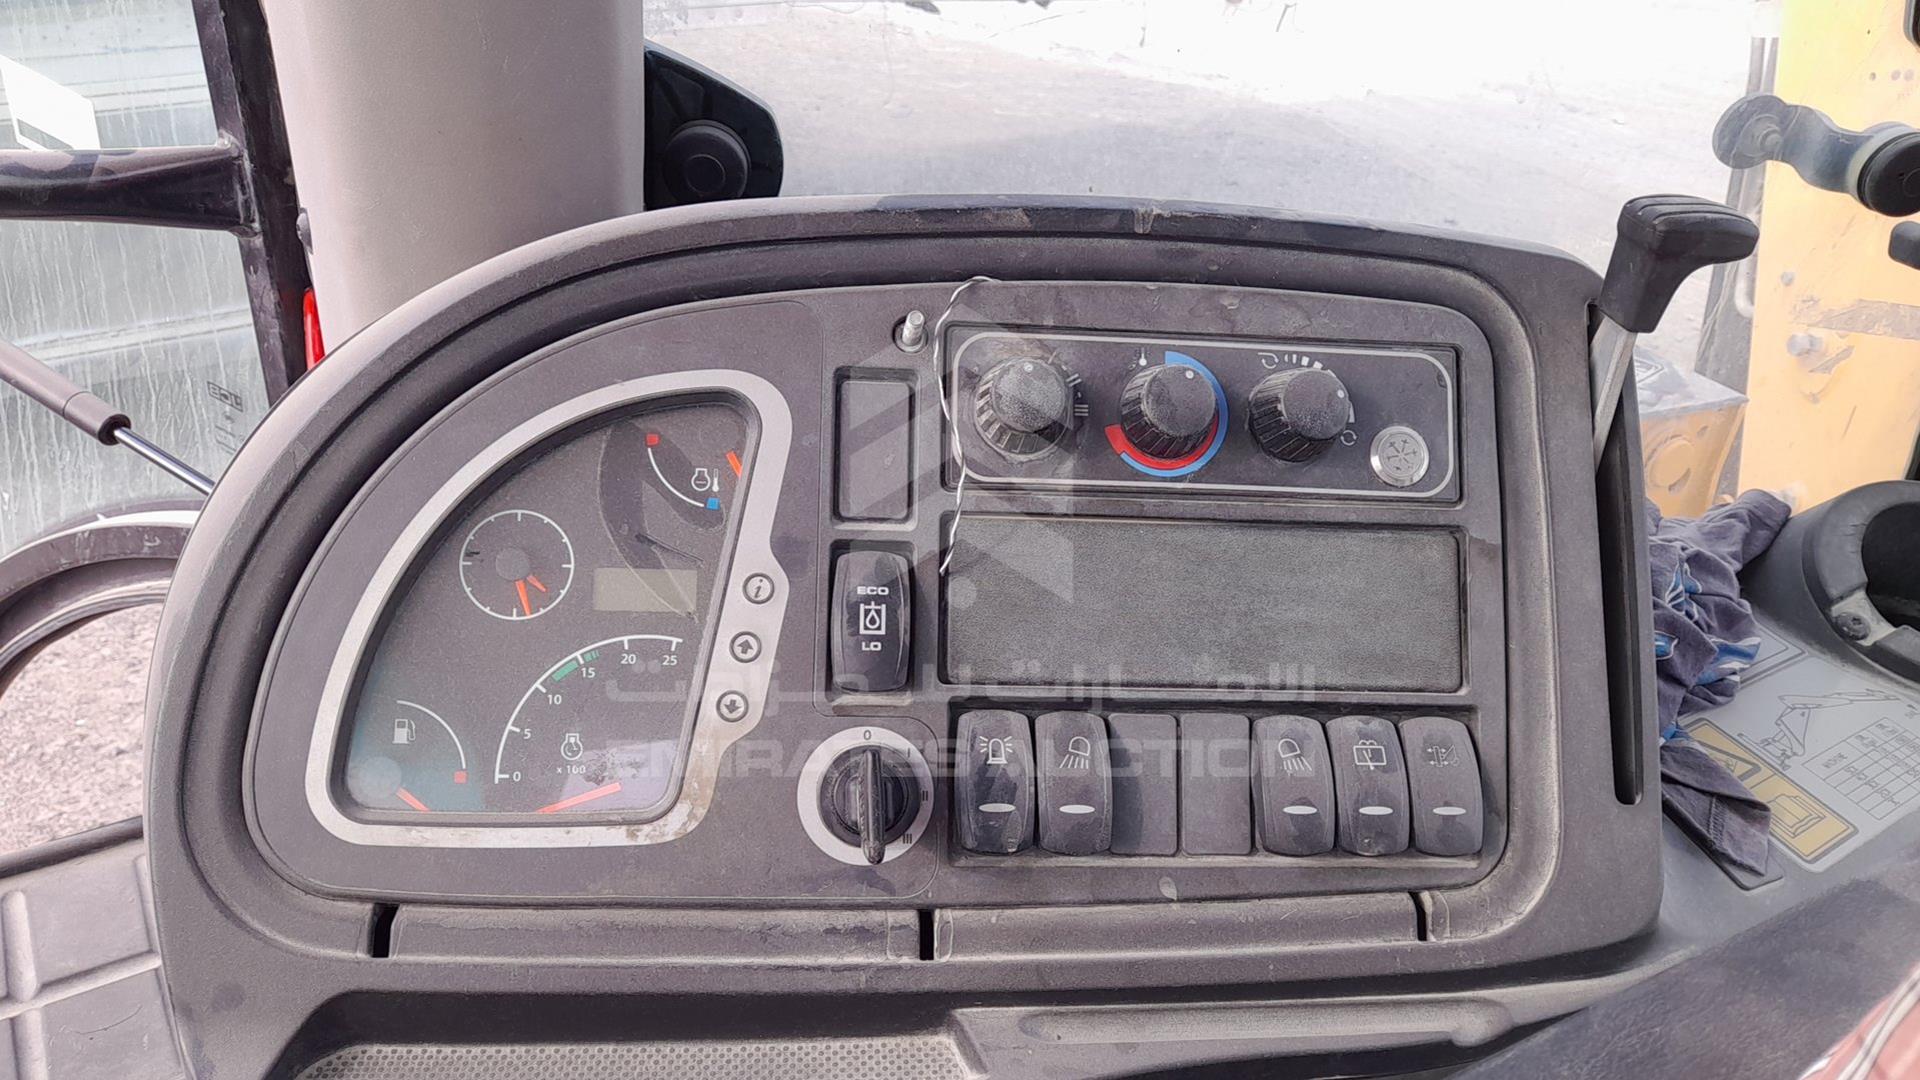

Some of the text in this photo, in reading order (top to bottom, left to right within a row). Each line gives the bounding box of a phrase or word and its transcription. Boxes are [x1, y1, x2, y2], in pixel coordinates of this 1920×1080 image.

[856, 585, 889, 596] ECO
[861, 641, 882, 652] LO
[620, 653, 637, 665] 20
[662, 655, 678, 666] 25
[581, 667, 596, 679] 15
[547, 694, 562, 705] 10
[523, 729, 532, 740] 5
[566, 765, 587, 774] 100
[512, 771, 522, 782] 0
